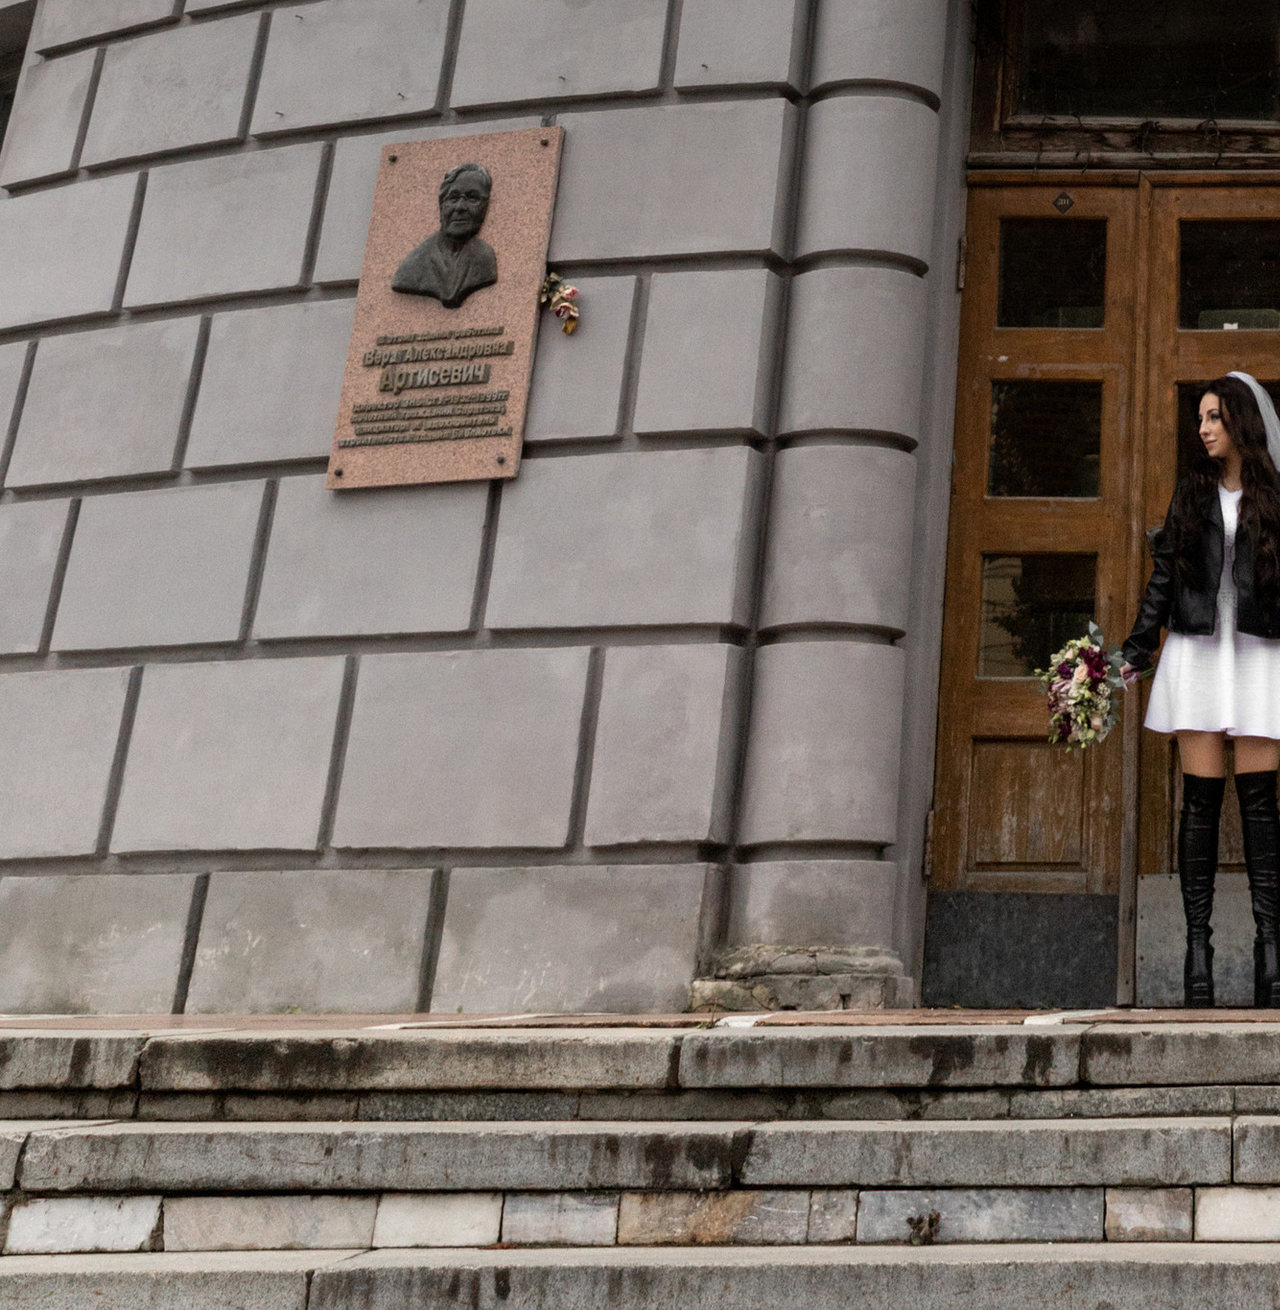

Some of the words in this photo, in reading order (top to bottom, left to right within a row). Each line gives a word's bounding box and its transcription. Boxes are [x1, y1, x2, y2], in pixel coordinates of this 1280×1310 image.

[363, 347, 398, 368] Вера
[404, 340, 514, 363] Александровна
[379, 363, 491, 395] Артисевич
